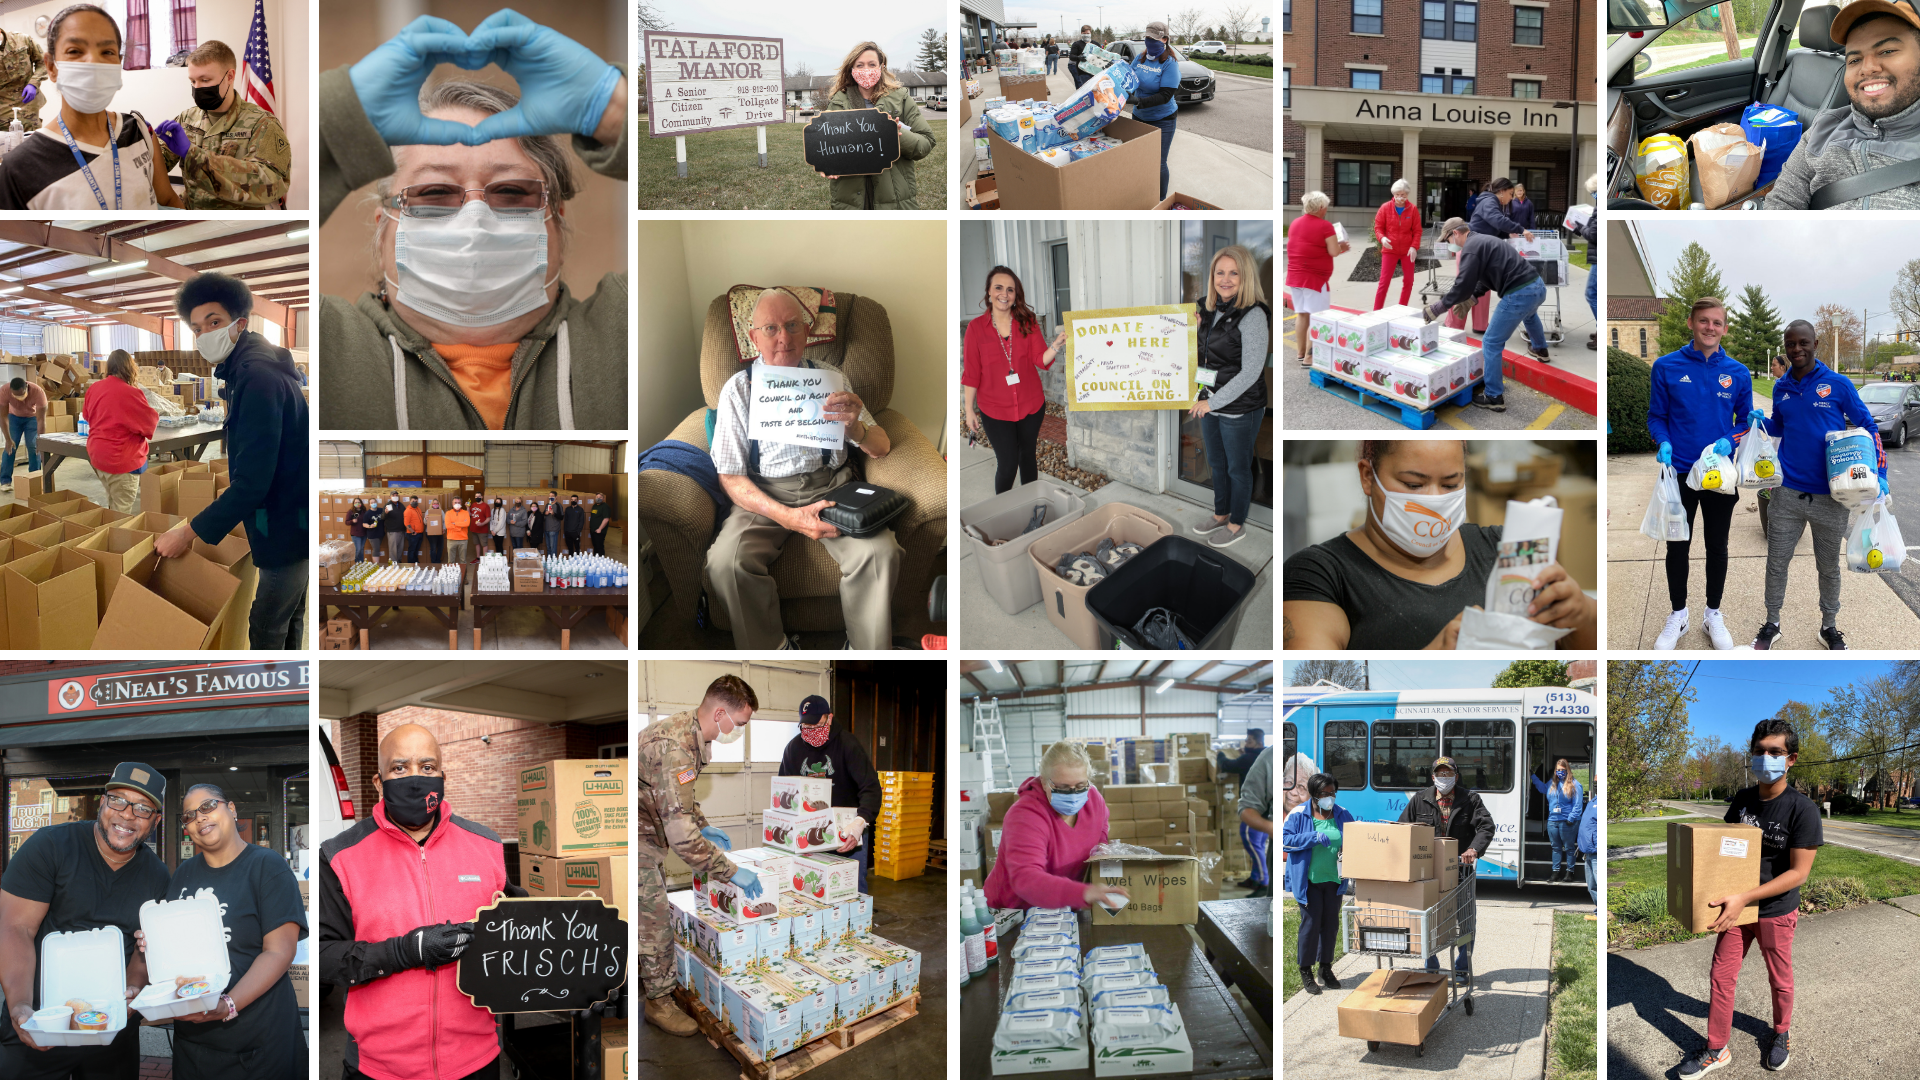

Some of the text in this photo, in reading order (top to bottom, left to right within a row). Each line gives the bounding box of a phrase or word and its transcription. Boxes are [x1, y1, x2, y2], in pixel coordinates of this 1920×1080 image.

[651, 38, 779, 60] TALAFORD
[678, 61, 763, 80] MANOR
[665, 87, 707, 98] A Senior
[671, 102, 703, 113] Citizen
[738, 97, 779, 110] Tollgate
[745, 110, 773, 120] Drive
[1355, 98, 1558, 127] Anna Louise Inn
[661, 115, 712, 129] Community
[814, 117, 879, 136] Thank You
[1075, 322, 1144, 338] DONATE
[1127, 337, 1170, 348] HERE
[767, 377, 822, 389] THANK YOU
[1081, 379, 1171, 391] COUNCIL ON
[759, 394, 792, 403] COUNCIL
[1126, 390, 1175, 401] AGING
[1852, 472, 1867, 480] BIG
[1413, 517, 1452, 539] COA
[115, 676, 188, 700] NEAL'S
[195, 670, 290, 693] FAMOUS
[1545, 693, 1577, 704] (513)
[1387, 707, 1430, 715] CINCINNATI
[1453, 706, 1481, 714] SENIOR
[1482, 706, 1519, 714] SERVICES
[1532, 705, 1589, 715] 721-4330
[522, 771, 545, 784] U-HAUL
[586, 782, 621, 791] U-HAUL
[17, 806, 44, 819] BUD
[576, 807, 597, 820] 100%
[12, 817, 50, 829] LIGHT
[567, 866, 598, 878] U-HAUL
[1105, 875, 1187, 889] Wet Wipes
[1127, 903, 1163, 913] 40 Bags
[486, 909, 599, 942] Thank You
[482, 942, 621, 978] FRISCH'S
